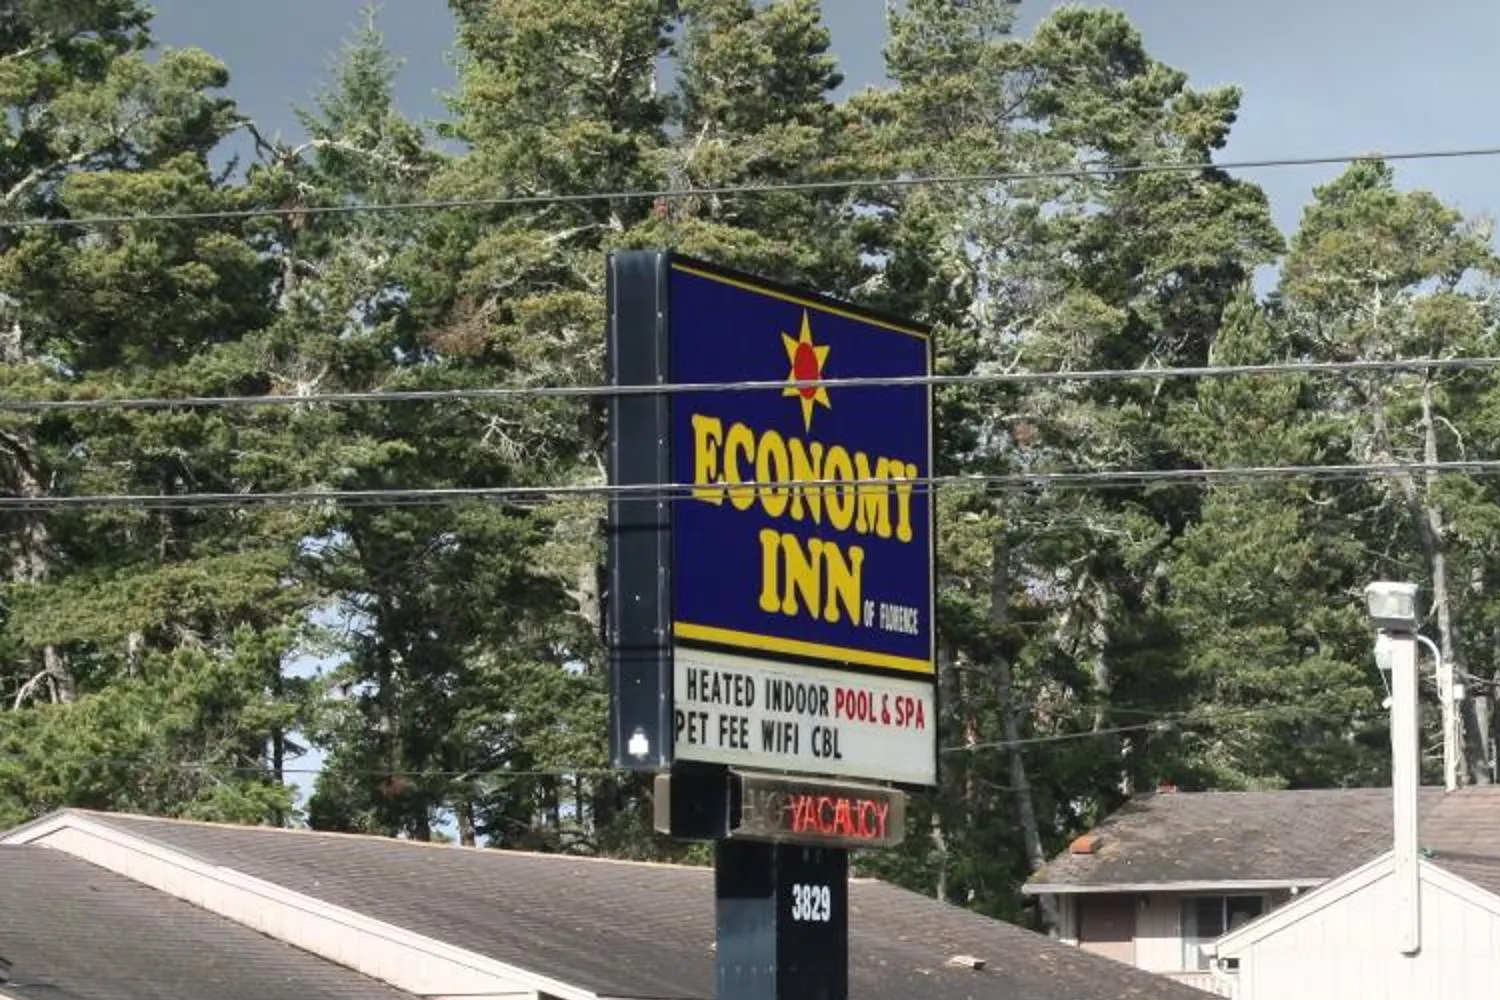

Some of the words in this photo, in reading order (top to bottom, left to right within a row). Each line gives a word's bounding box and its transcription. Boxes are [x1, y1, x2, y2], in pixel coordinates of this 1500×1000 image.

[692, 414, 918, 543] ECONOMY
[759, 528, 864, 626] INN
[863, 599, 875, 628] OF
[687, 667, 755, 707] HEATED
[765, 678, 829, 718] INDOOR
[834, 687, 877, 724] POOL
[881, 694, 891, 726] &
[895, 695, 925, 730] SPA
[675, 708, 709, 744] PET
[719, 714, 749, 750] FEE
[761, 719, 799, 756] WIFI
[811, 724, 842, 760] CBL
[791, 796, 889, 839] VACANCY
[791, 884, 831, 922] 3829
